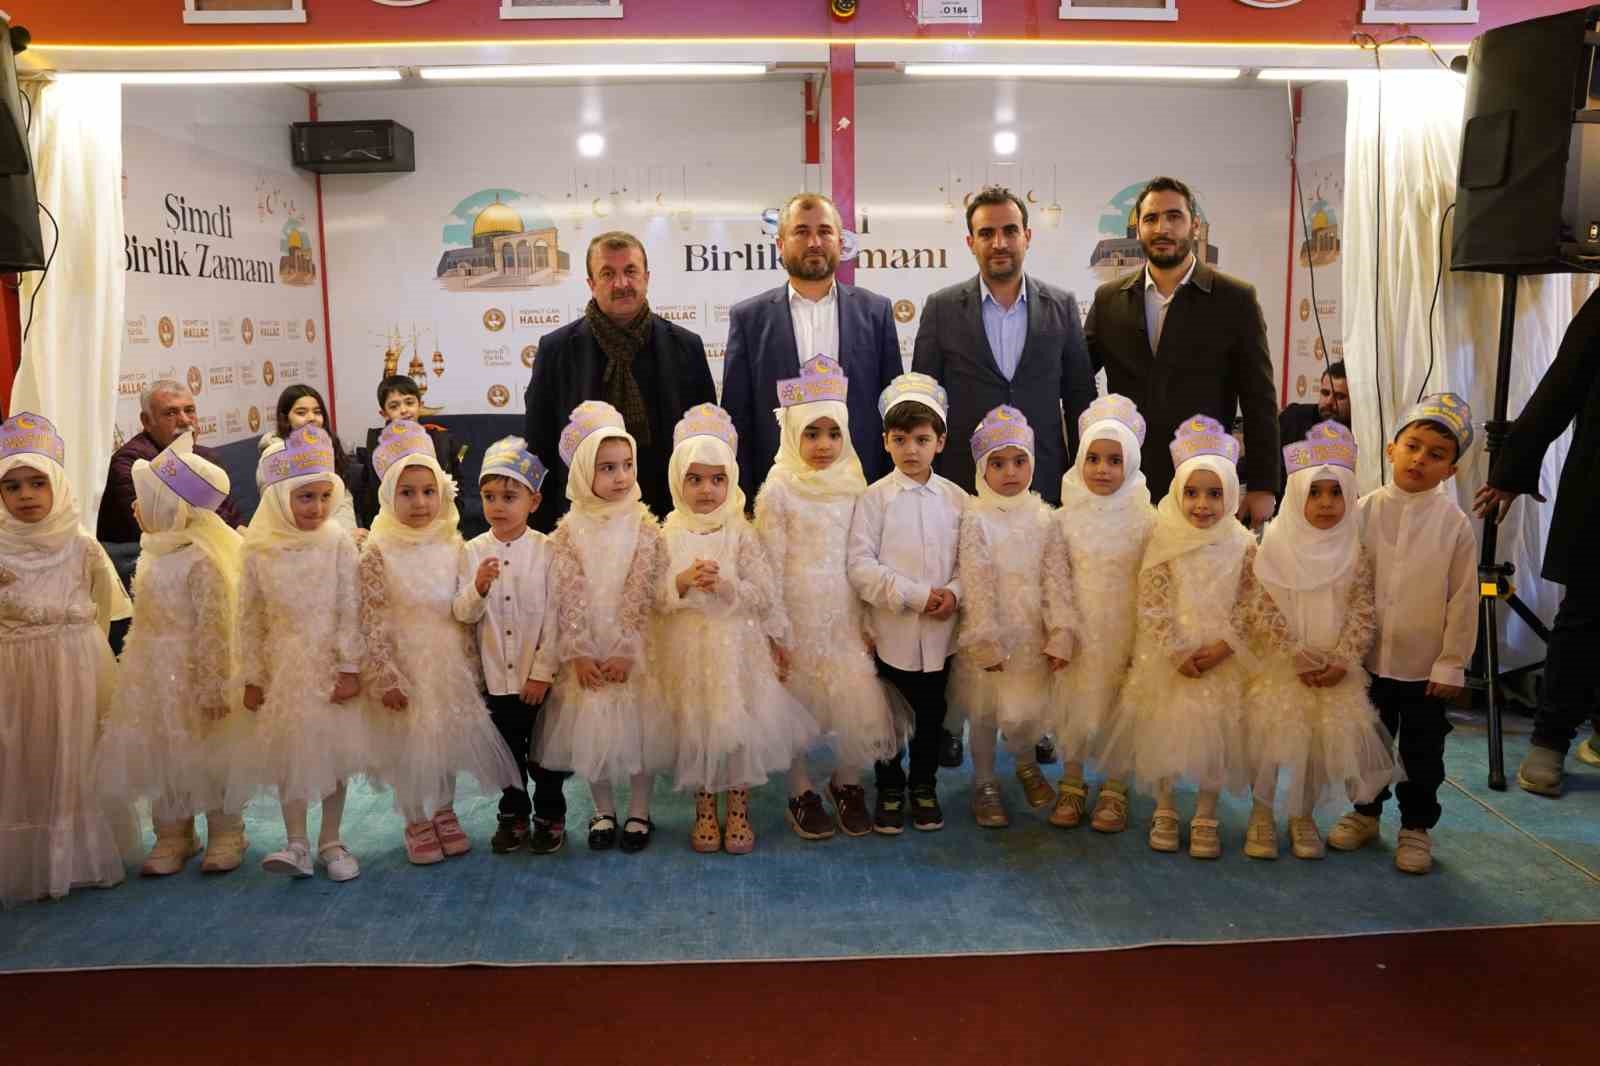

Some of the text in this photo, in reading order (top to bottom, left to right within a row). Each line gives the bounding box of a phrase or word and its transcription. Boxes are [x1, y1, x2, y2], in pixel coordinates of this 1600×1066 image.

[164, 193, 232, 238] Şimdi
[195, 243, 275, 283] Zamanı
[685, 243, 947, 271] Birlik manı
